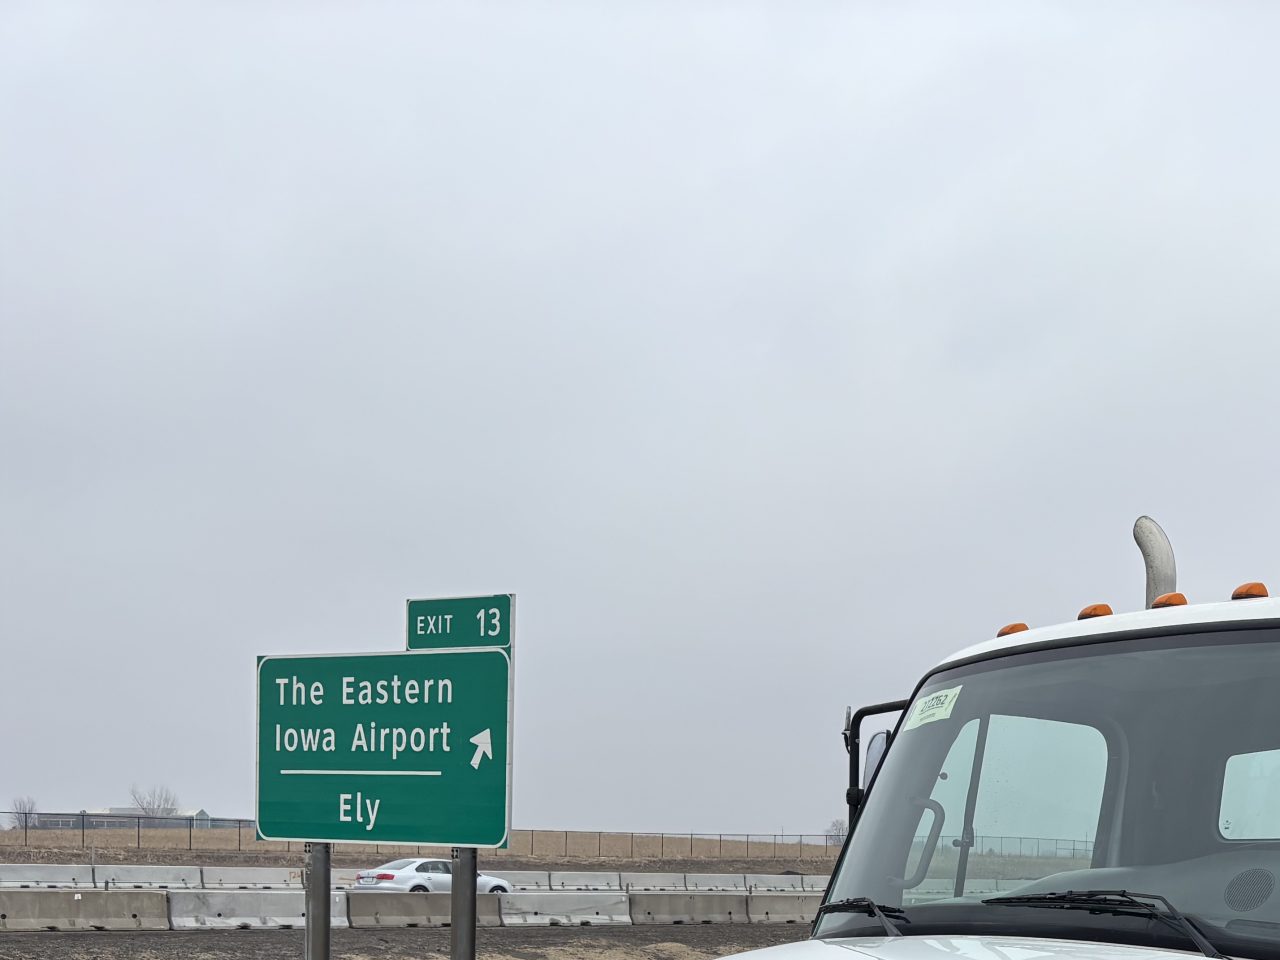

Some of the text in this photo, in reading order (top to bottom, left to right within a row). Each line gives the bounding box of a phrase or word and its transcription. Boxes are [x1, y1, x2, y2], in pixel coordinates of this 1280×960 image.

[416, 607, 501, 637] EXIT 13
[275, 674, 453, 706] The Eastern
[275, 721, 451, 760] Iowa Airport
[339, 792, 381, 831] Ely
